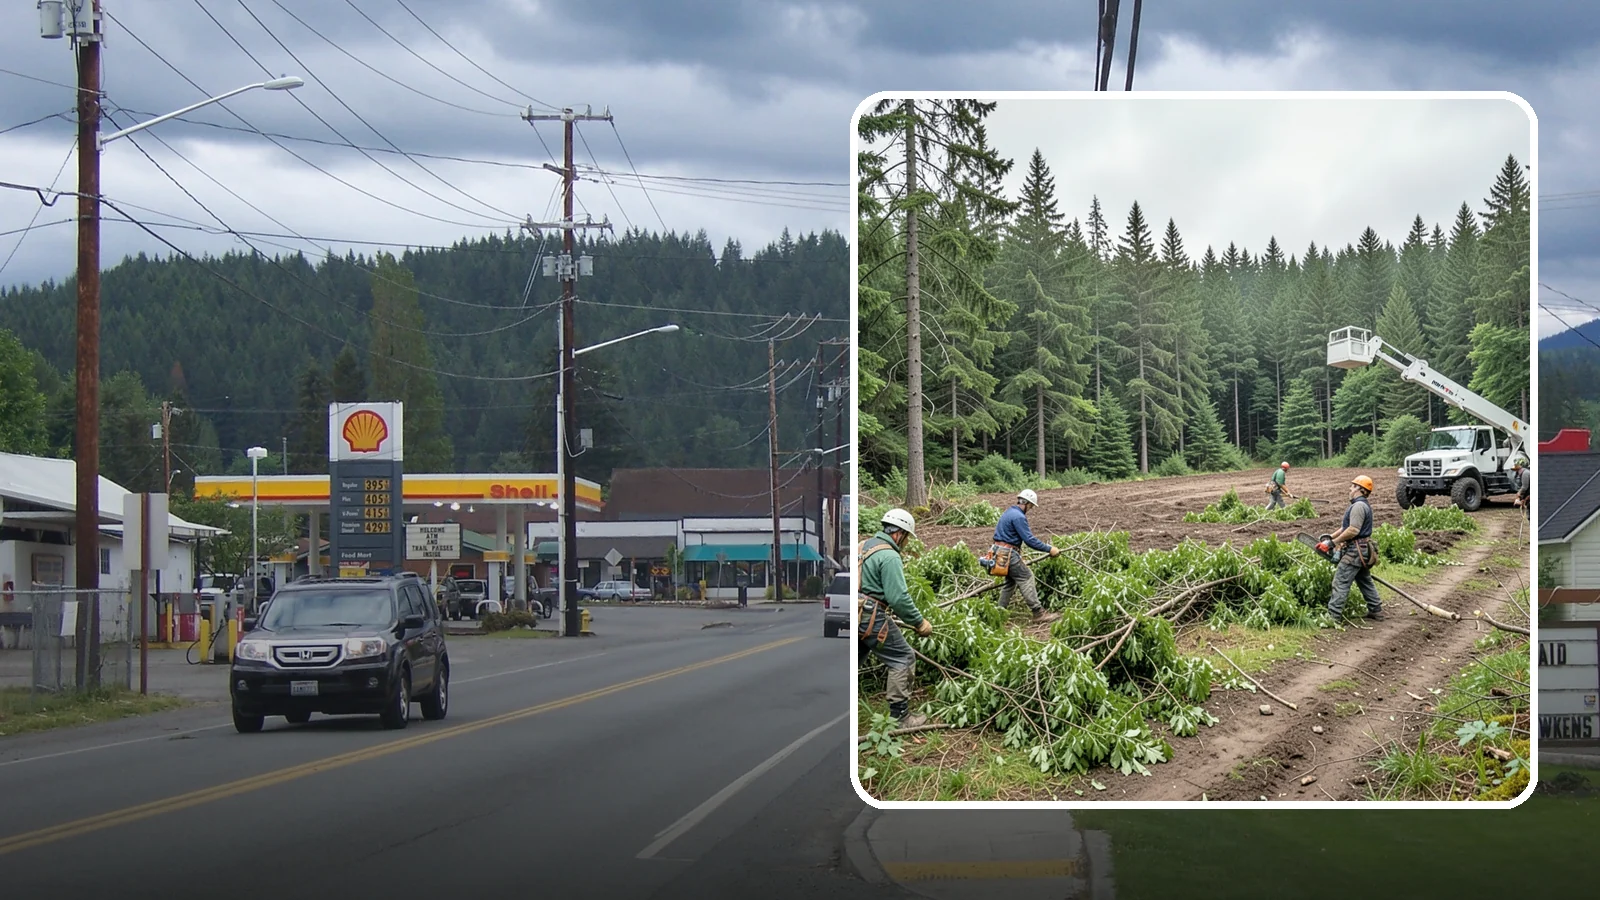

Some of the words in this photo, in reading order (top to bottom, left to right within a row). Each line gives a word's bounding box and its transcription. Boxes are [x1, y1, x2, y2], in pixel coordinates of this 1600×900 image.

[366, 480, 383, 490] 395
[490, 484, 547, 499] Shell
[366, 494, 383, 504] 405
[366, 508, 383, 518] 415
[366, 522, 383, 532] 429
